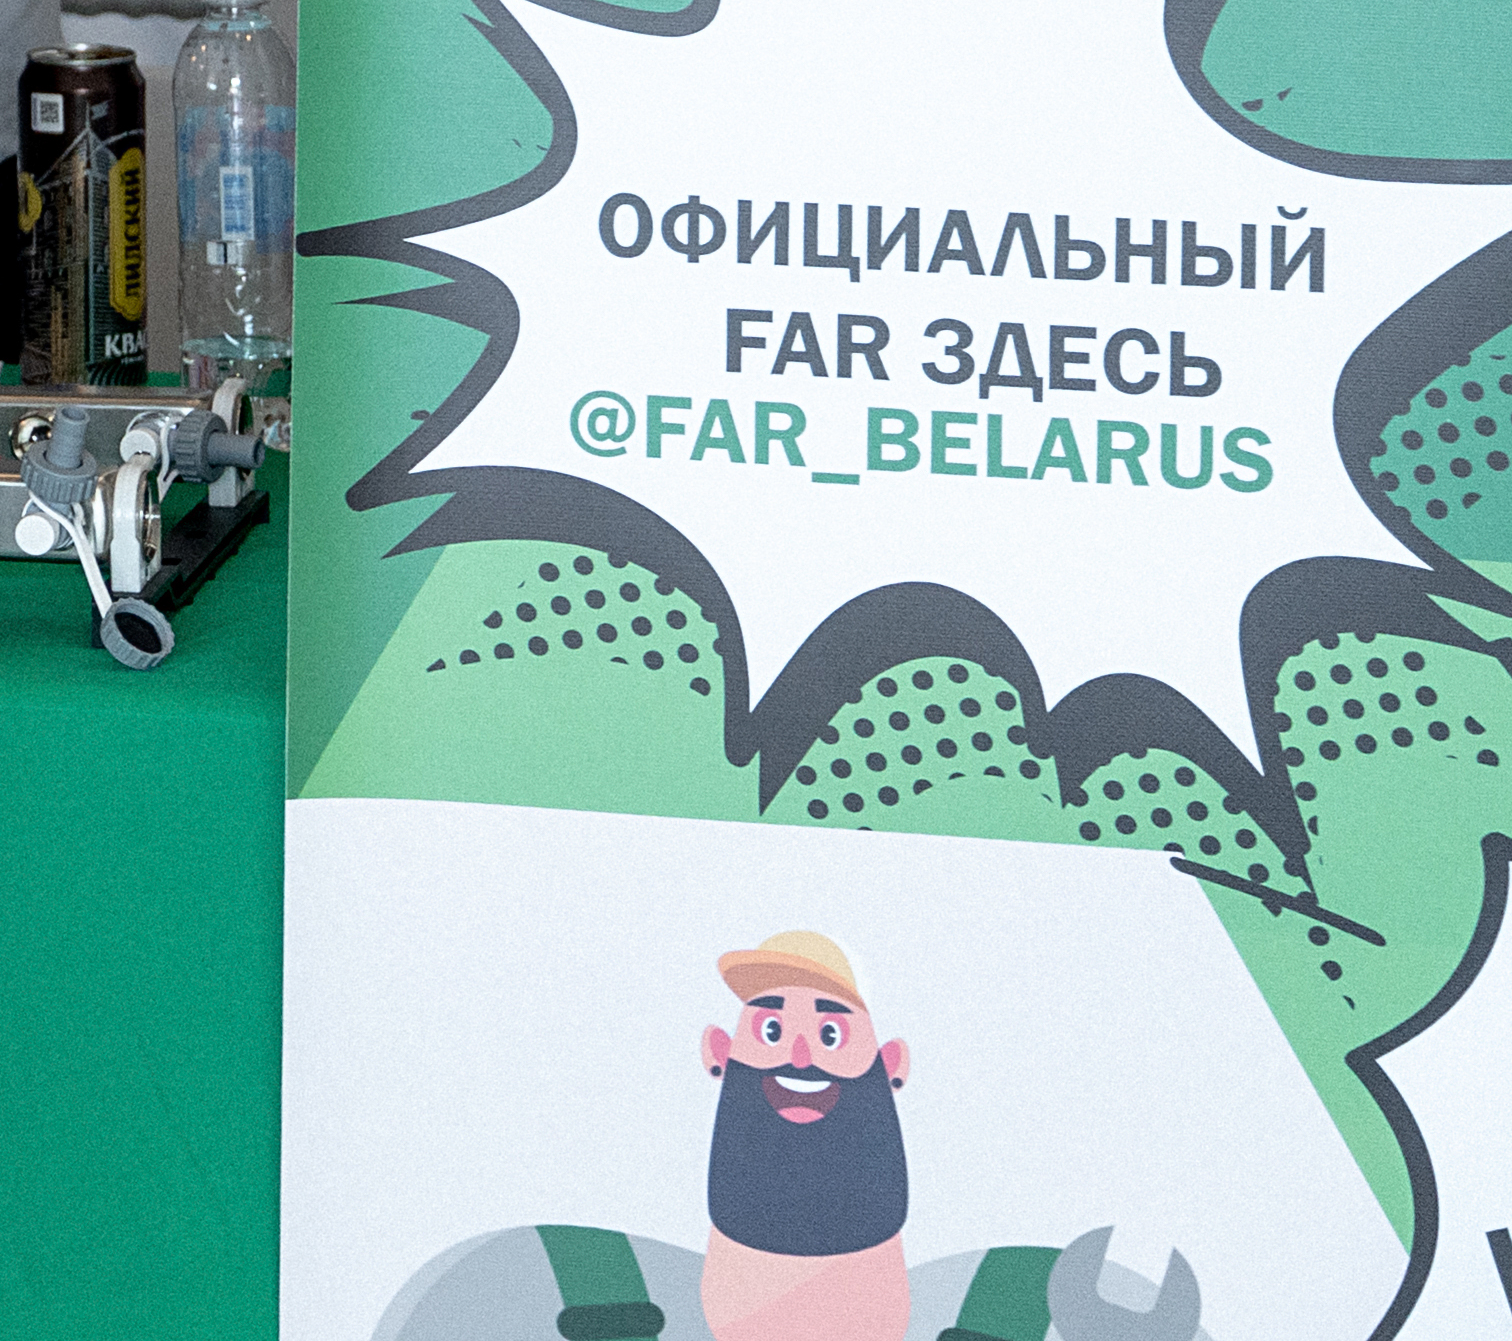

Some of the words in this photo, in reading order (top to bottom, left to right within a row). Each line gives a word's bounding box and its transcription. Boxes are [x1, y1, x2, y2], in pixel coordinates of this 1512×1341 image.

[597, 192, 1327, 295] ОФИЦИАЛЬНЫЙ
[724, 307, 892, 382] FAR
[920, 318, 1224, 403] ЗДЕСЬ
[569, 390, 1276, 494] @FAR_BELARUS
